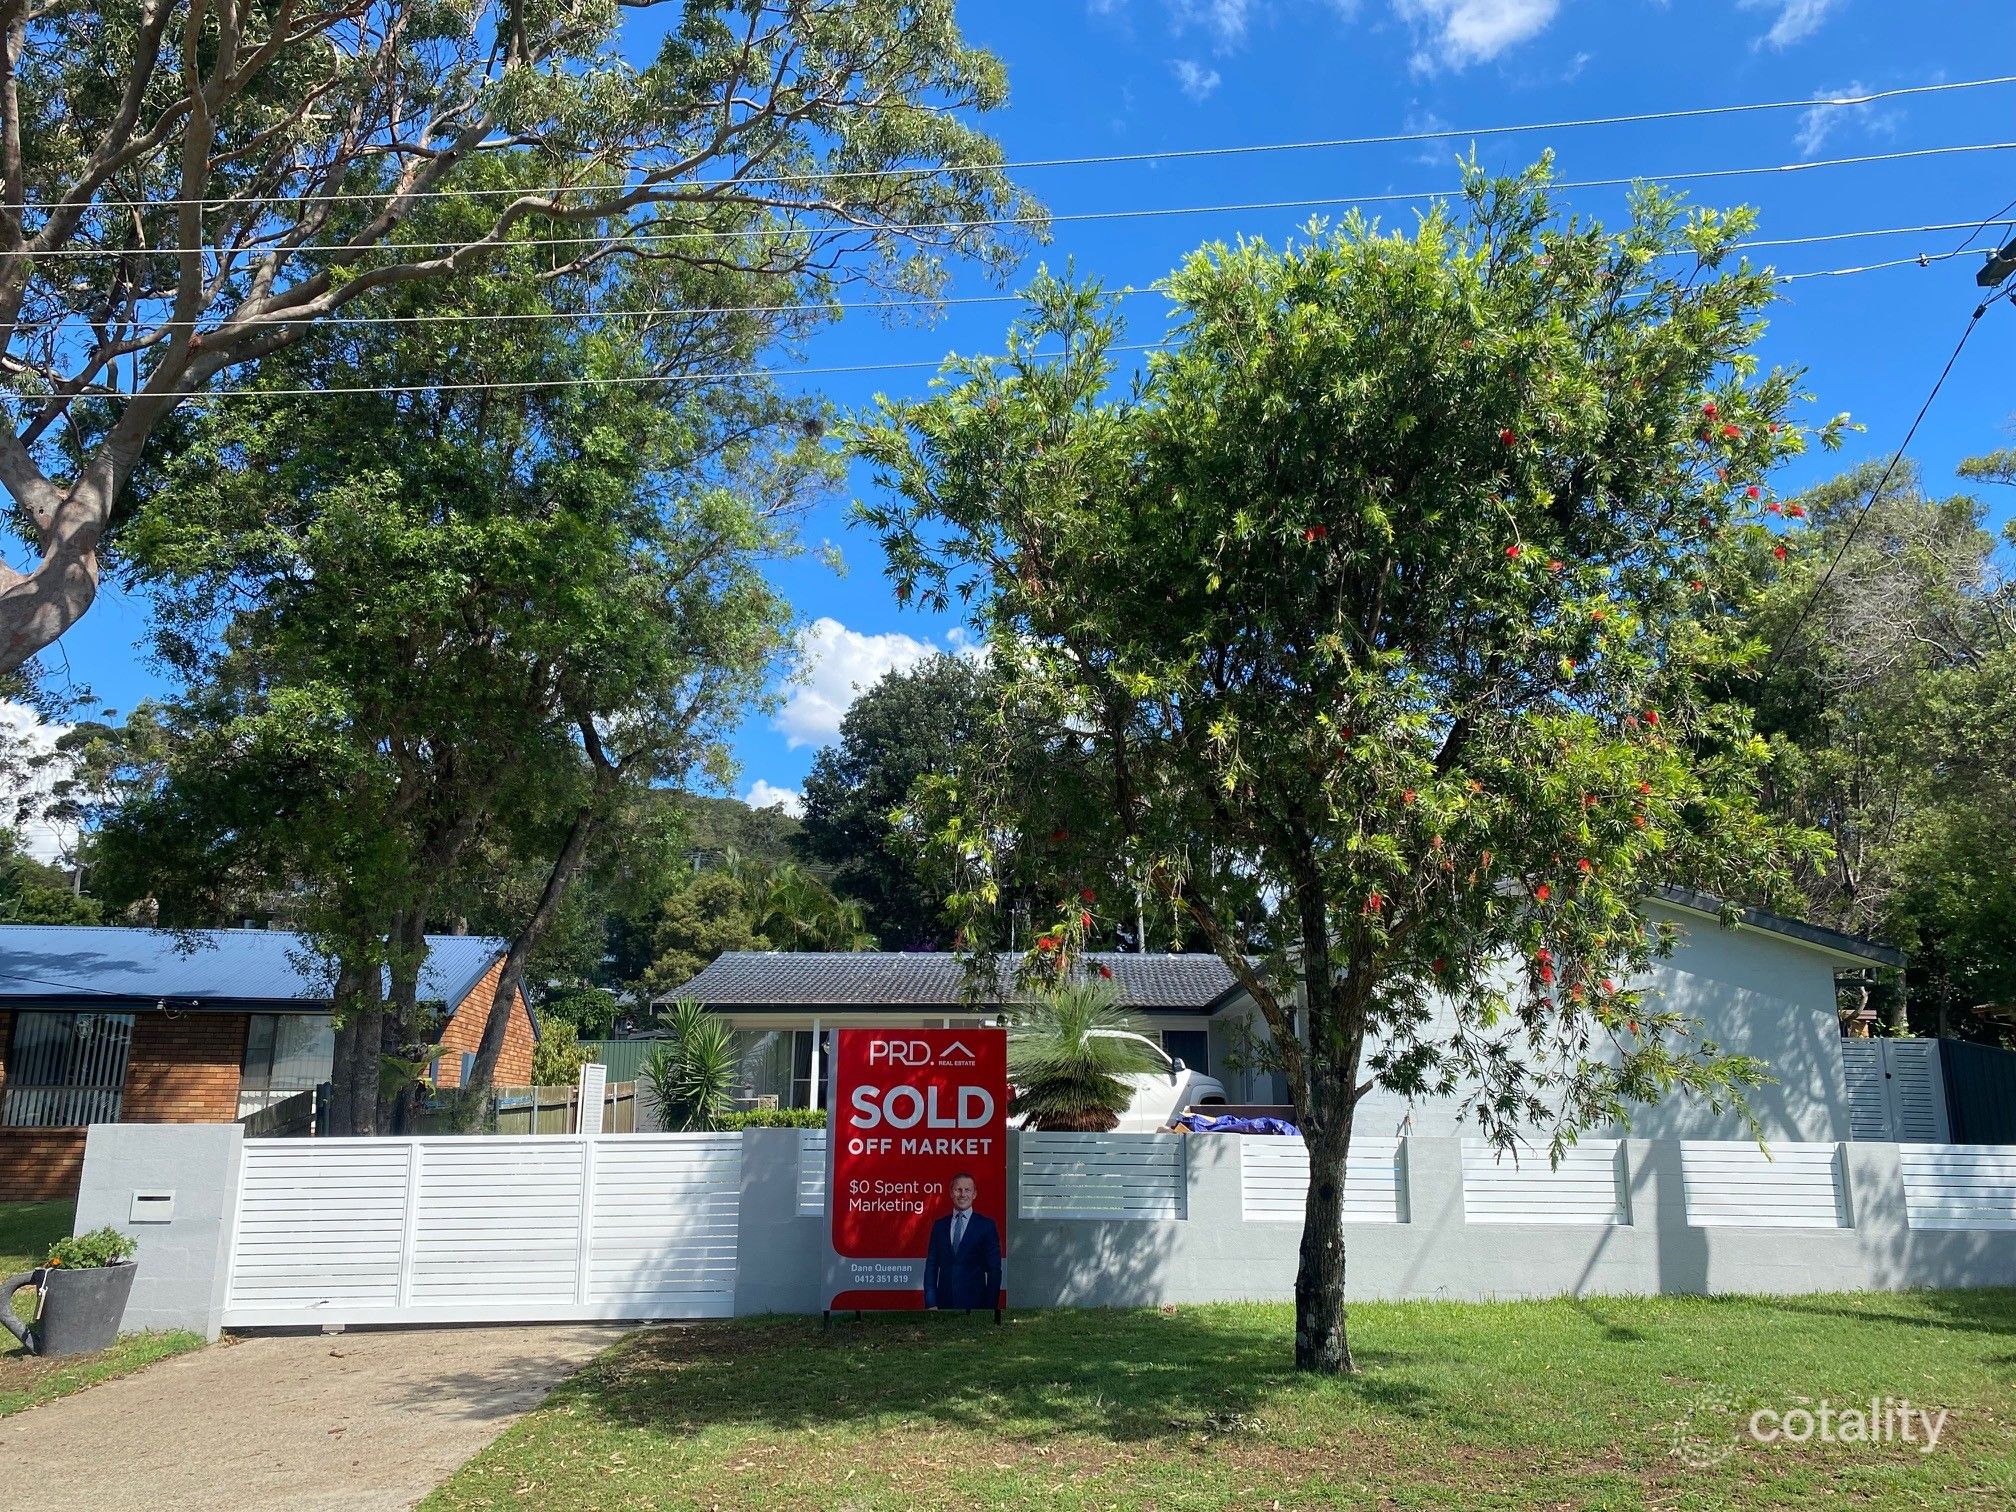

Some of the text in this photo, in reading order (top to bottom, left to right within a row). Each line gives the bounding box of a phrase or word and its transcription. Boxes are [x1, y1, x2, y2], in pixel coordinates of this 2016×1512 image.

[850, 1085, 995, 1129] SOLD
[848, 1138, 992, 1155] OFF MARKET
[849, 1179, 943, 1196] $0 Spent on
[849, 1198, 924, 1214] Marketing
[851, 1263, 912, 1272] Dane Queenan
[854, 1275, 909, 1283] 0412 351 819
